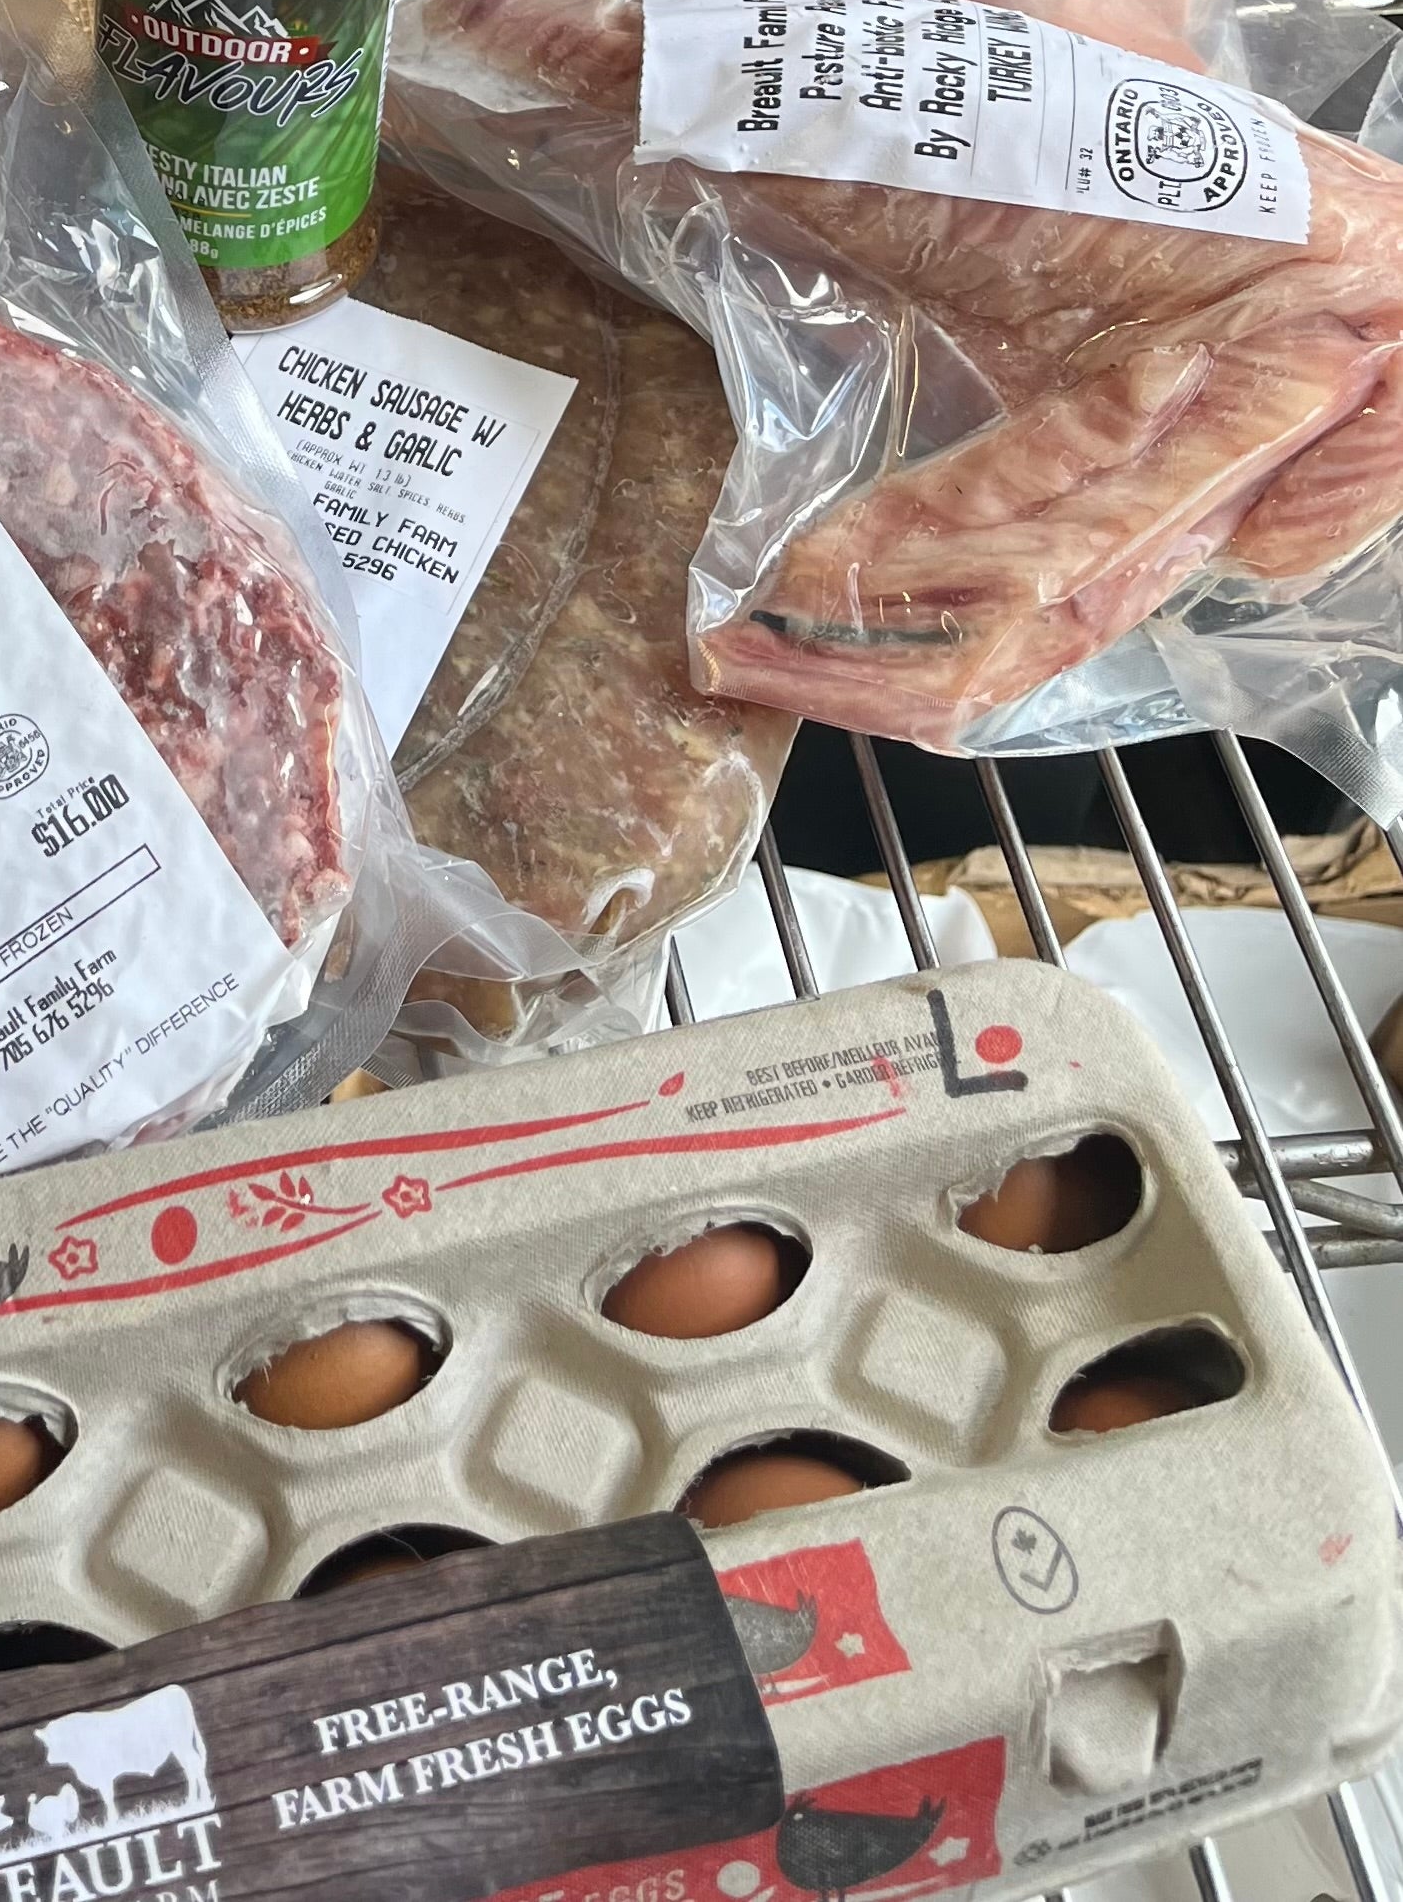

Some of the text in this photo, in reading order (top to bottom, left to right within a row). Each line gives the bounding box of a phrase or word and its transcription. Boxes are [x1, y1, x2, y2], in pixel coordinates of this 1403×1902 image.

[142, 14, 291, 64] OUTDOOR
[921, 8, 976, 44] Ridge
[99, 14, 365, 127] FLAVOURS
[737, 57, 783, 131] Breault
[799, 23, 845, 100] Pasture
[859, 15, 905, 111] Anti-biotic
[918, 51, 978, 117] Rocky
[987, 37, 1032, 102] TURKEY
[149, 145, 198, 181] ESTY
[203, 164, 287, 188] ITALIAN
[914, 128, 971, 160] By
[1079, 147, 1093, 160] 32
[1106, 89, 1148, 182] ONTARIO
[1182, 102, 1243, 206] APPROVED
[193, 185, 250, 210] AVEC
[255, 176, 321, 210] ZESTE
[260, 206, 328, 239] D'ÉPICES
[1258, 173, 1277, 214] KEEP
[278, 345, 507, 448] CHICKEN SAUSAGE W/
[276, 390, 462, 477] HERBS & GARLIC
[312, 484, 458, 558] FAMILY FARM
[324, 480, 357, 499] GARLIC
[342, 552, 398, 581] 5296
[372, 536, 459, 584] CHICKEN
[31, 774, 129, 857] $16.00
[36, 776, 95, 818] Total Price
[23, 975, 80, 1017] Family
[73, 950, 117, 981] Farm
[32, 1010, 69, 1044] 676
[66, 977, 114, 1018] 5296
[6, 1114, 47, 1149] THE
[45, 1053, 124, 1116] "QUALITY"
[134, 972, 239, 1055] DIFFERENCE
[745, 1038, 901, 1088] BEST BEFORE/MEILLEUR
[685, 1104, 719, 1124] KEEP
[720, 1079, 820, 1115] REFRIGERATED
[313, 1648, 619, 1757] FREE-RANGE,
[271, 1687, 693, 1832] FARM FRESH EGGS
